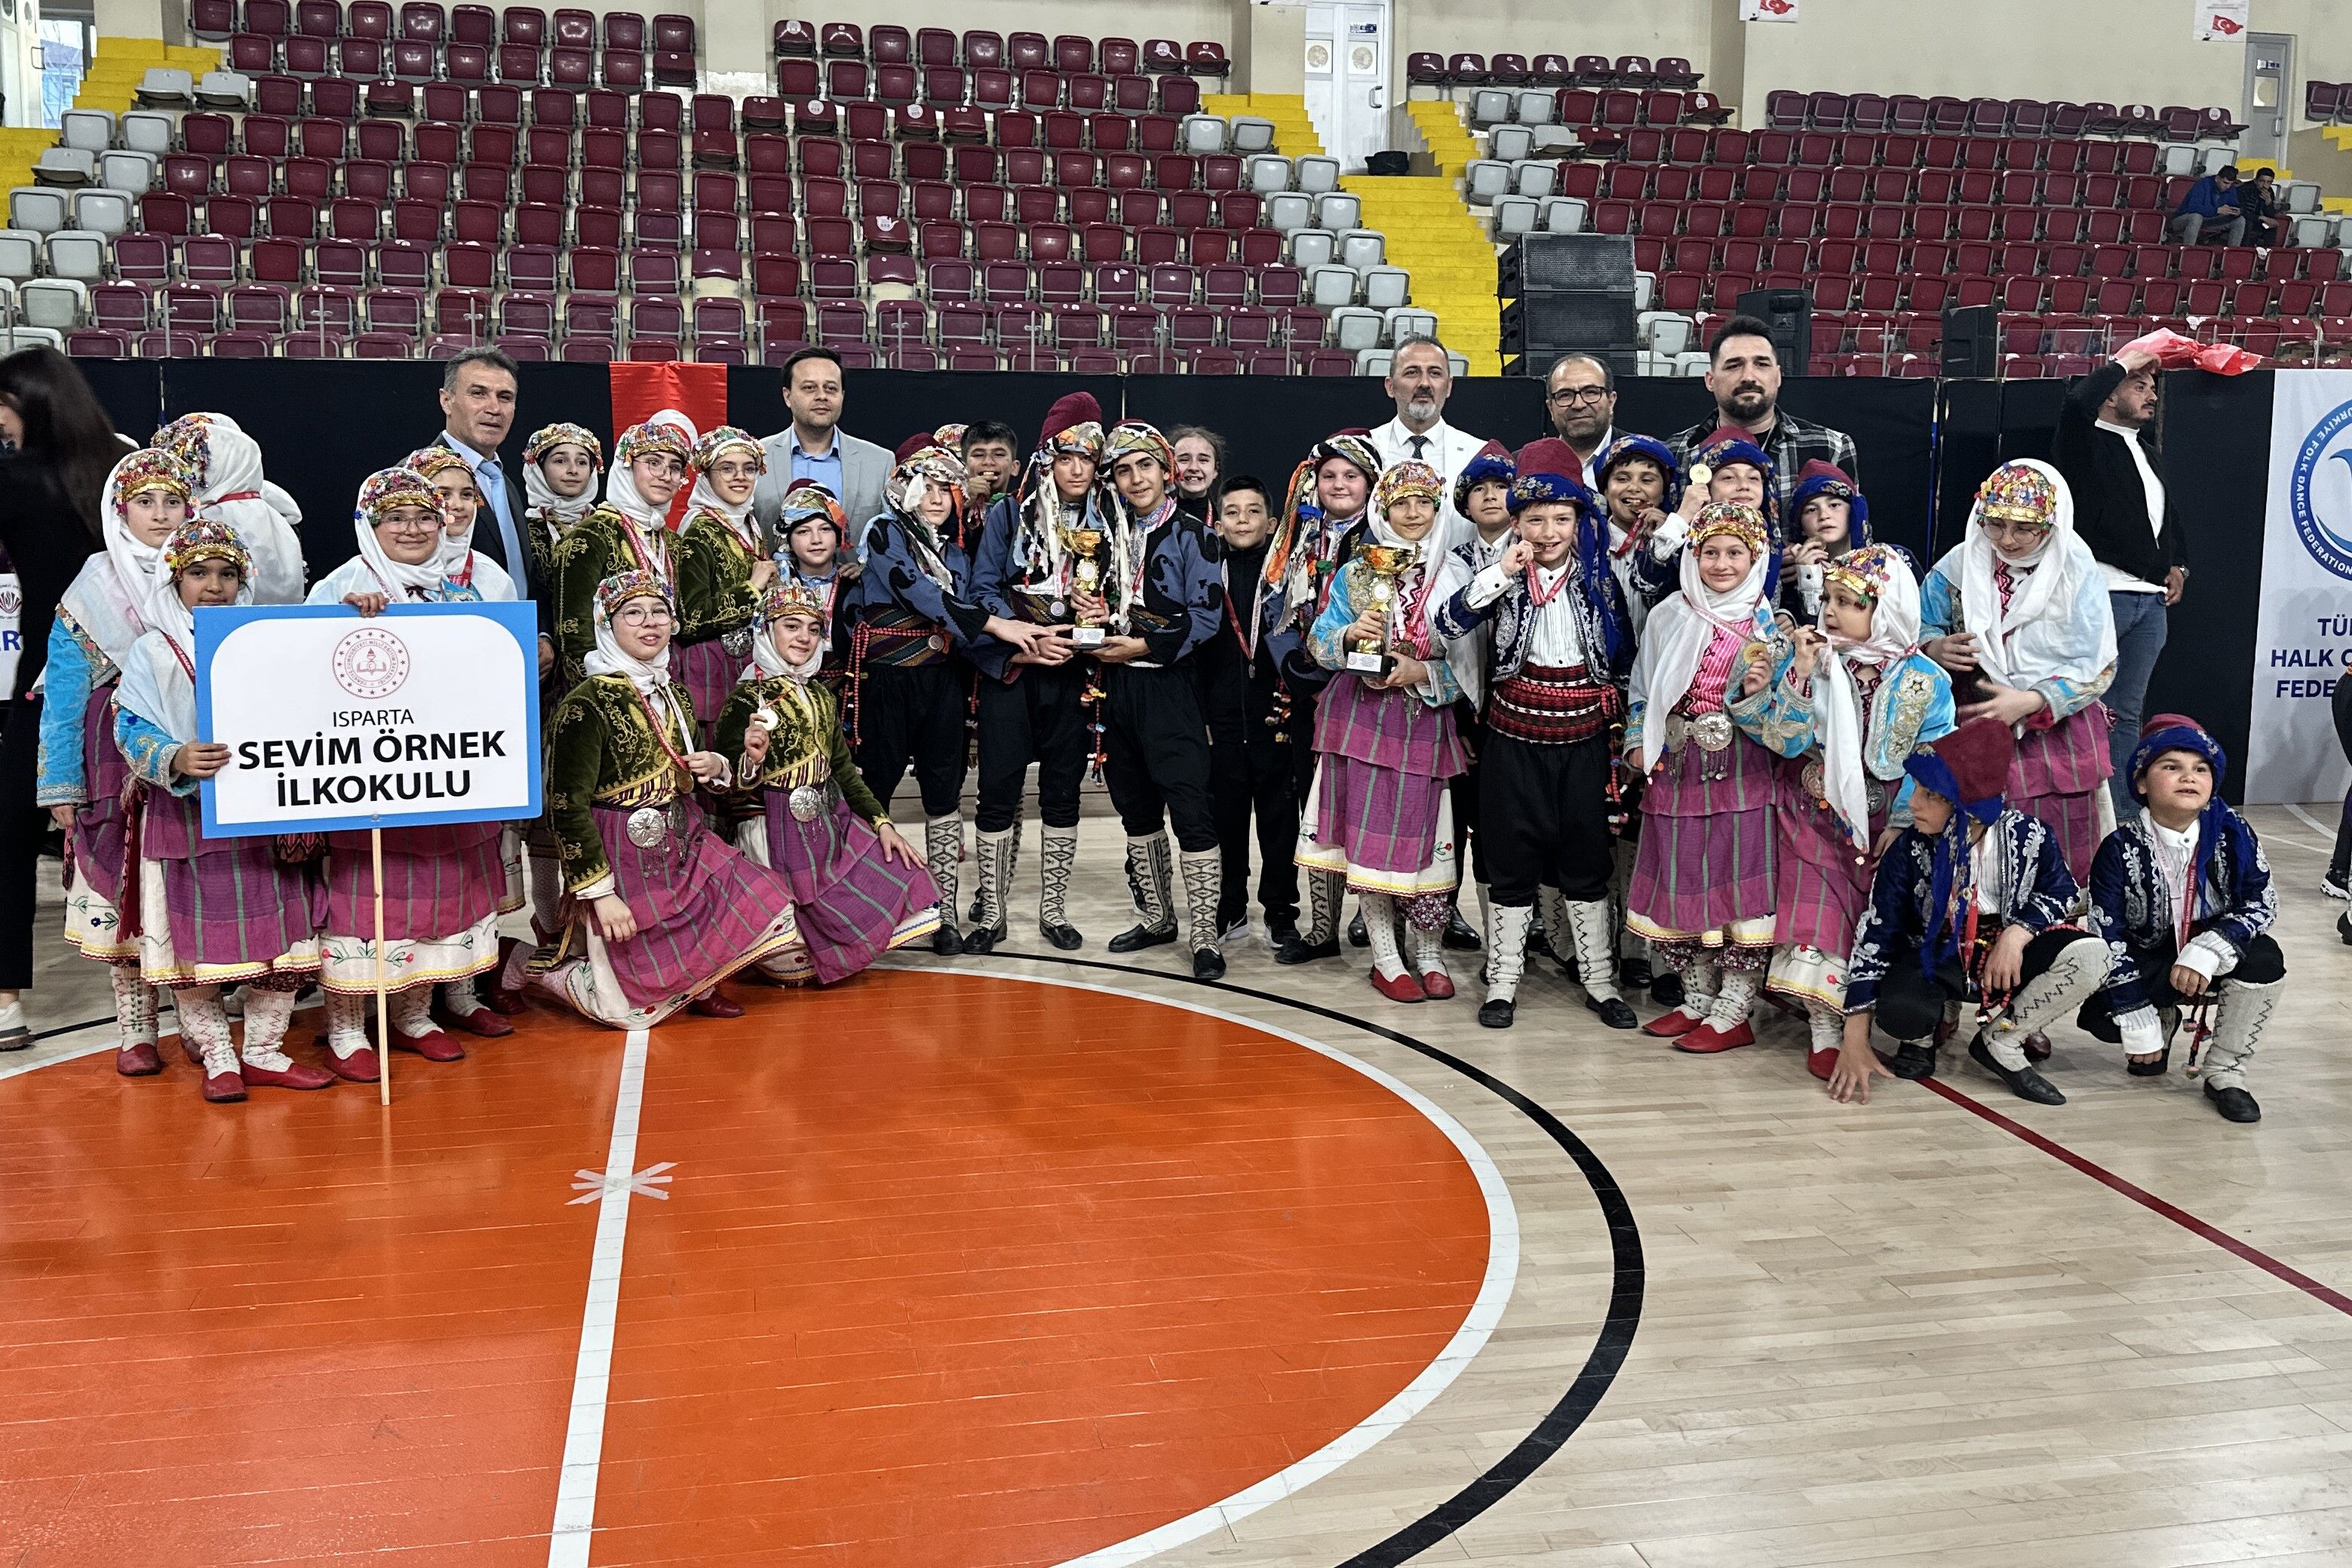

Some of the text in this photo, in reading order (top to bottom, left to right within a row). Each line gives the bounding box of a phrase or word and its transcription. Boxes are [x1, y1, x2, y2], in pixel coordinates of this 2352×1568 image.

[2300, 440, 2320, 471] FOLK
[2296, 477, 2307, 518] DANCE
[2317, 614, 2352, 637] TÜ
[2271, 649, 2334, 667] HALK
[333, 709, 414, 728] ISPARTA
[238, 728, 506, 770] SEVİM ÖRNEK
[277, 769, 471, 808] İLKOKULU
